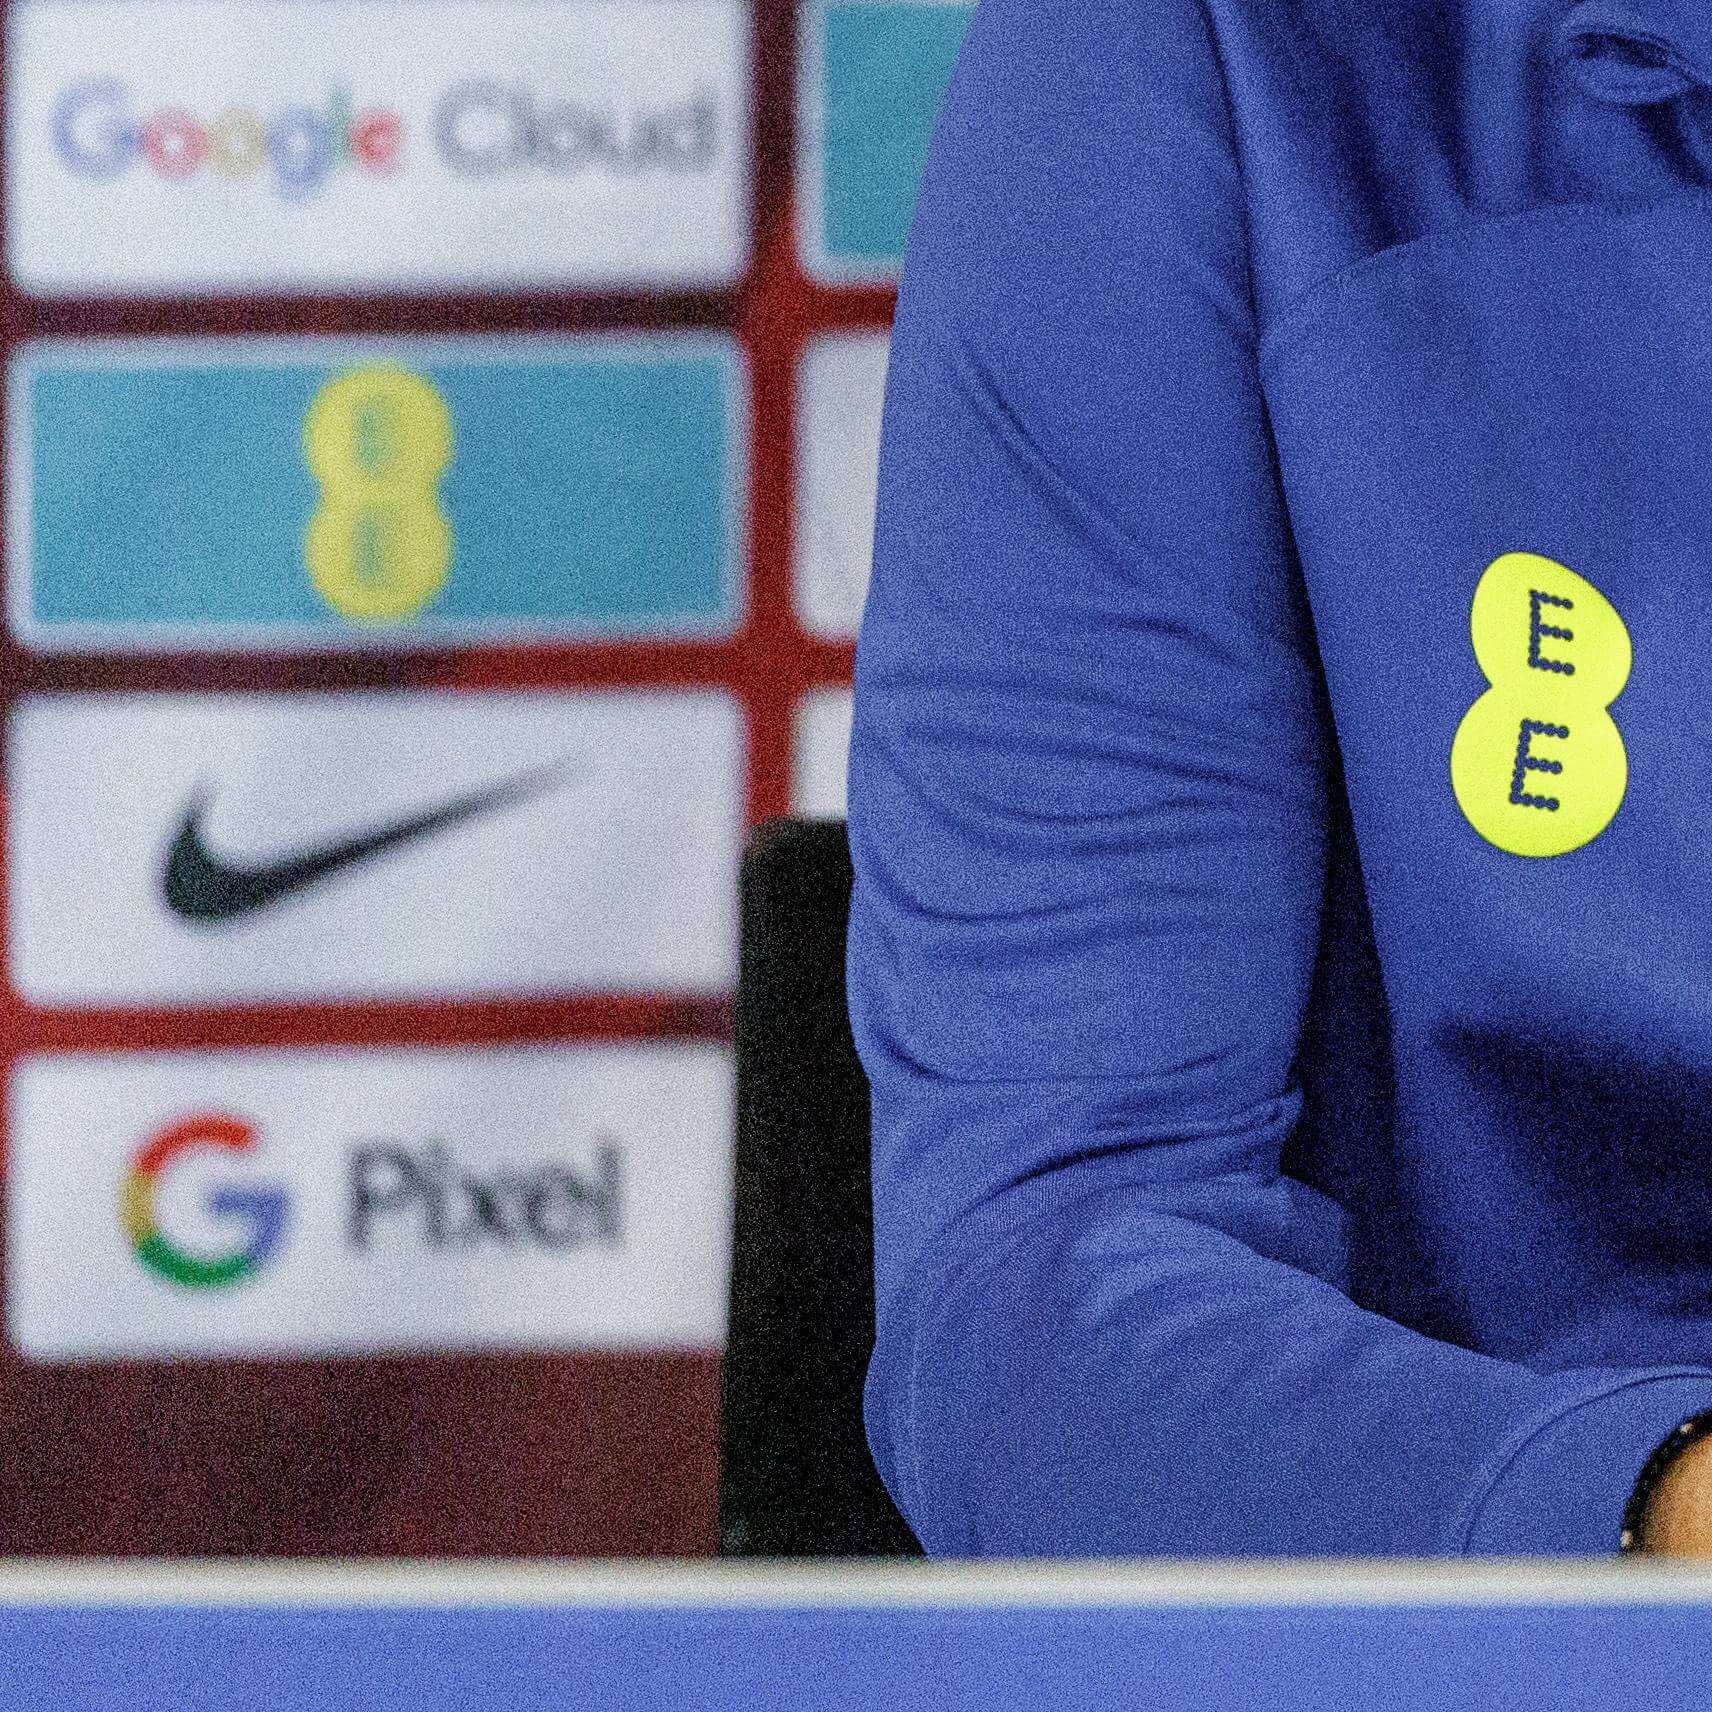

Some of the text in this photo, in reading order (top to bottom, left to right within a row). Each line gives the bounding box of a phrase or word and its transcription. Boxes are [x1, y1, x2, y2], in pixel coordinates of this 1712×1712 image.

[51, 82, 724, 202] Google Cloud
[346, 1141, 622, 1253] Pixel
